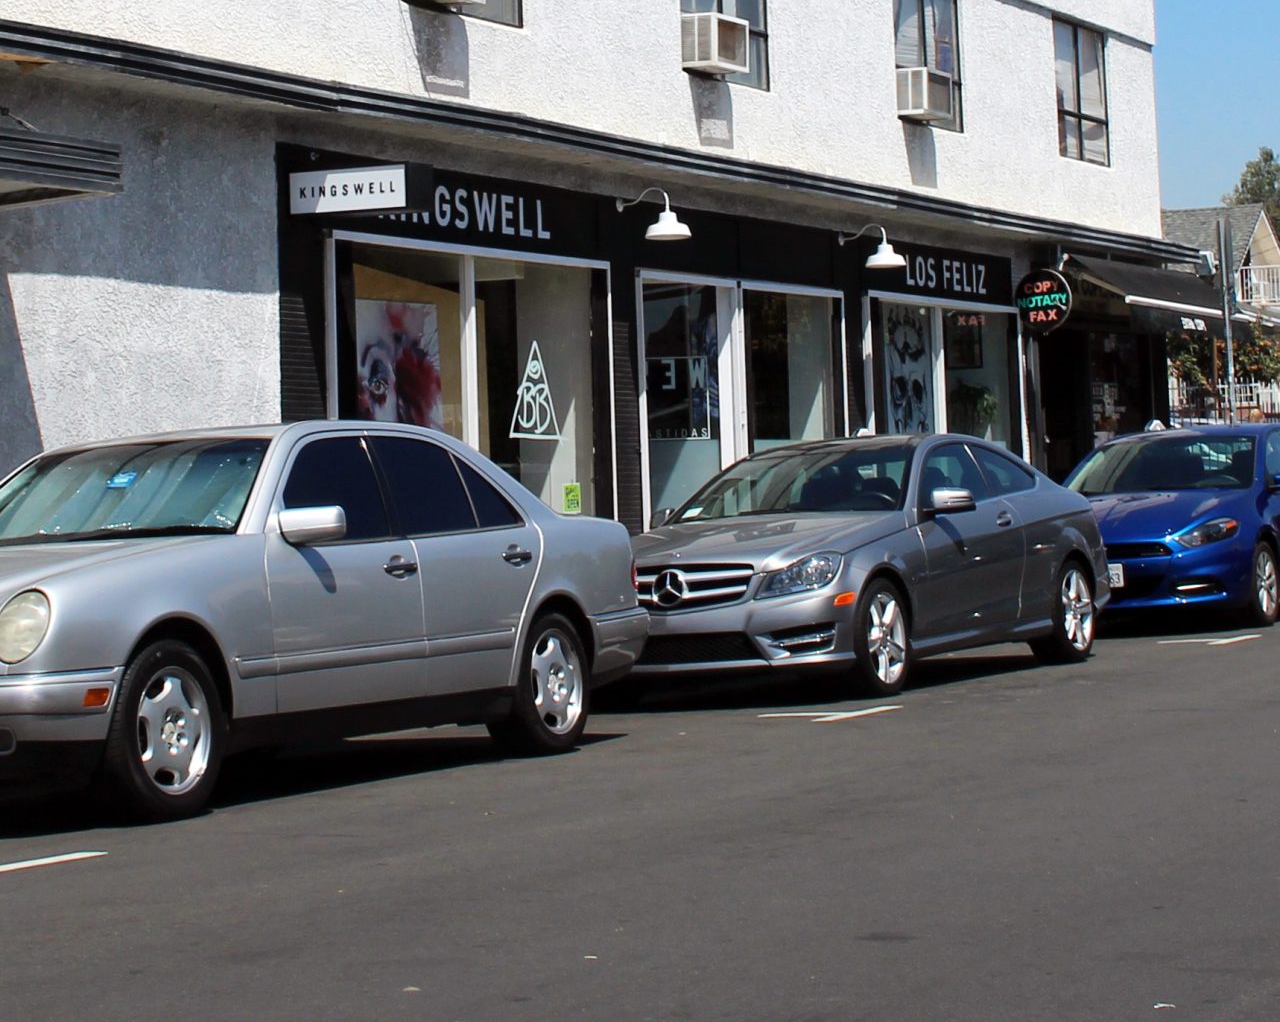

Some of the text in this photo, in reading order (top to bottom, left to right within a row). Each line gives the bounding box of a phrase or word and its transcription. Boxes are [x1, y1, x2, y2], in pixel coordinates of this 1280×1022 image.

[299, 181, 396, 199] KINGSWELL
[378, 185, 551, 240] GSWELL
[905, 254, 987, 295] LOS FELIZ
[1024, 280, 1059, 294] COPY
[1017, 293, 1067, 308] NOTARY
[1029, 309, 1058, 323] FAX
